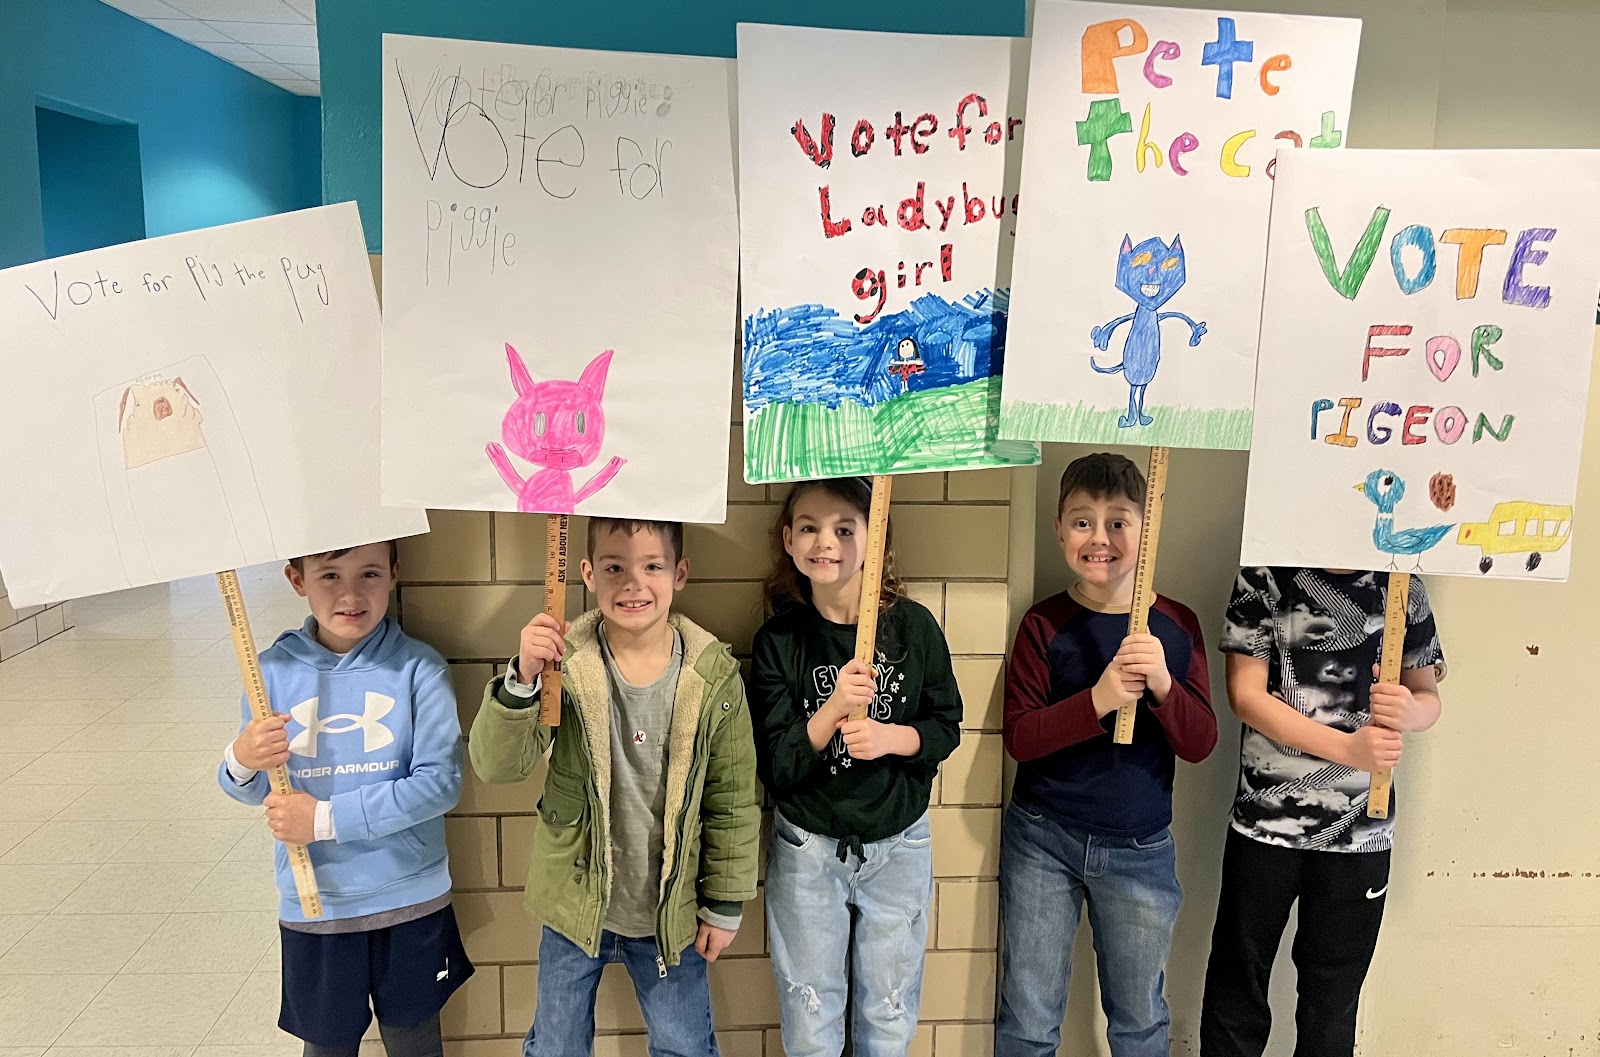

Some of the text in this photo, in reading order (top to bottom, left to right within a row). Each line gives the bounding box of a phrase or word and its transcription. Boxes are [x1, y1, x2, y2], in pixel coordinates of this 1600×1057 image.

[1081, 17, 1293, 100] Pete
[394, 57, 586, 200] Vote
[947, 93, 1023, 151] for
[1075, 97, 1200, 182] the
[851, 243, 953, 325] girl
[1304, 203, 1558, 310] VOTE
[25, 270, 124, 321] Vote
[142, 271, 172, 295] for
[232, 262, 267, 287] the
[1361, 323, 1505, 383] FOR
[1310, 396, 1516, 448] PIGEON
[559, 531, 567, 556] ABOUT
[559, 558, 567, 568] US
[558, 569, 566, 584] ASK
[291, 760, 400, 779] NDER ARMOUR
